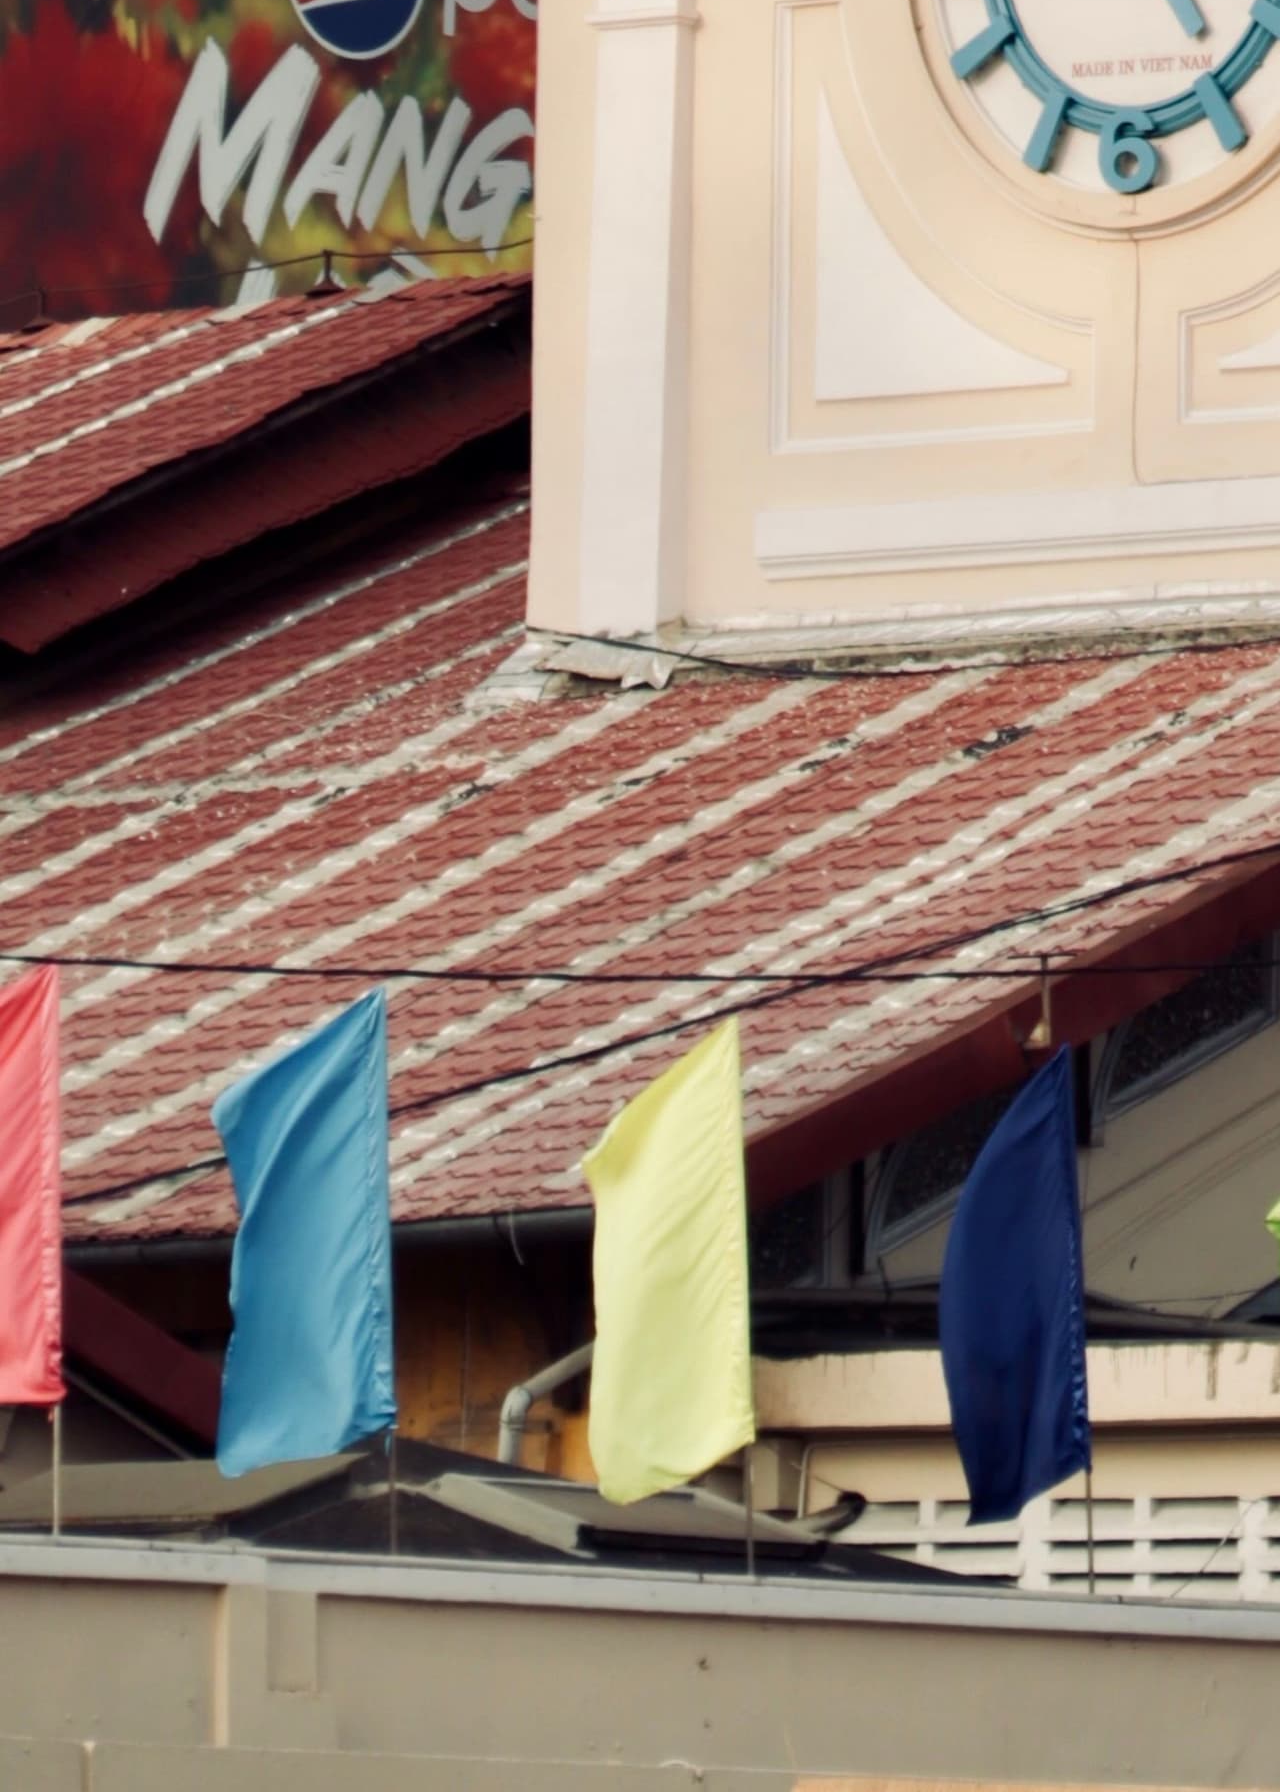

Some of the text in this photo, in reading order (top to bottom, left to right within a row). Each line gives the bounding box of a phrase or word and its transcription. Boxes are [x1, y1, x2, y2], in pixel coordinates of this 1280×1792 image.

[1072, 54, 1213, 78] MADE IN VIET NAM
[143, 35, 536, 263] MANG
[1098, 109, 1159, 195] 6
